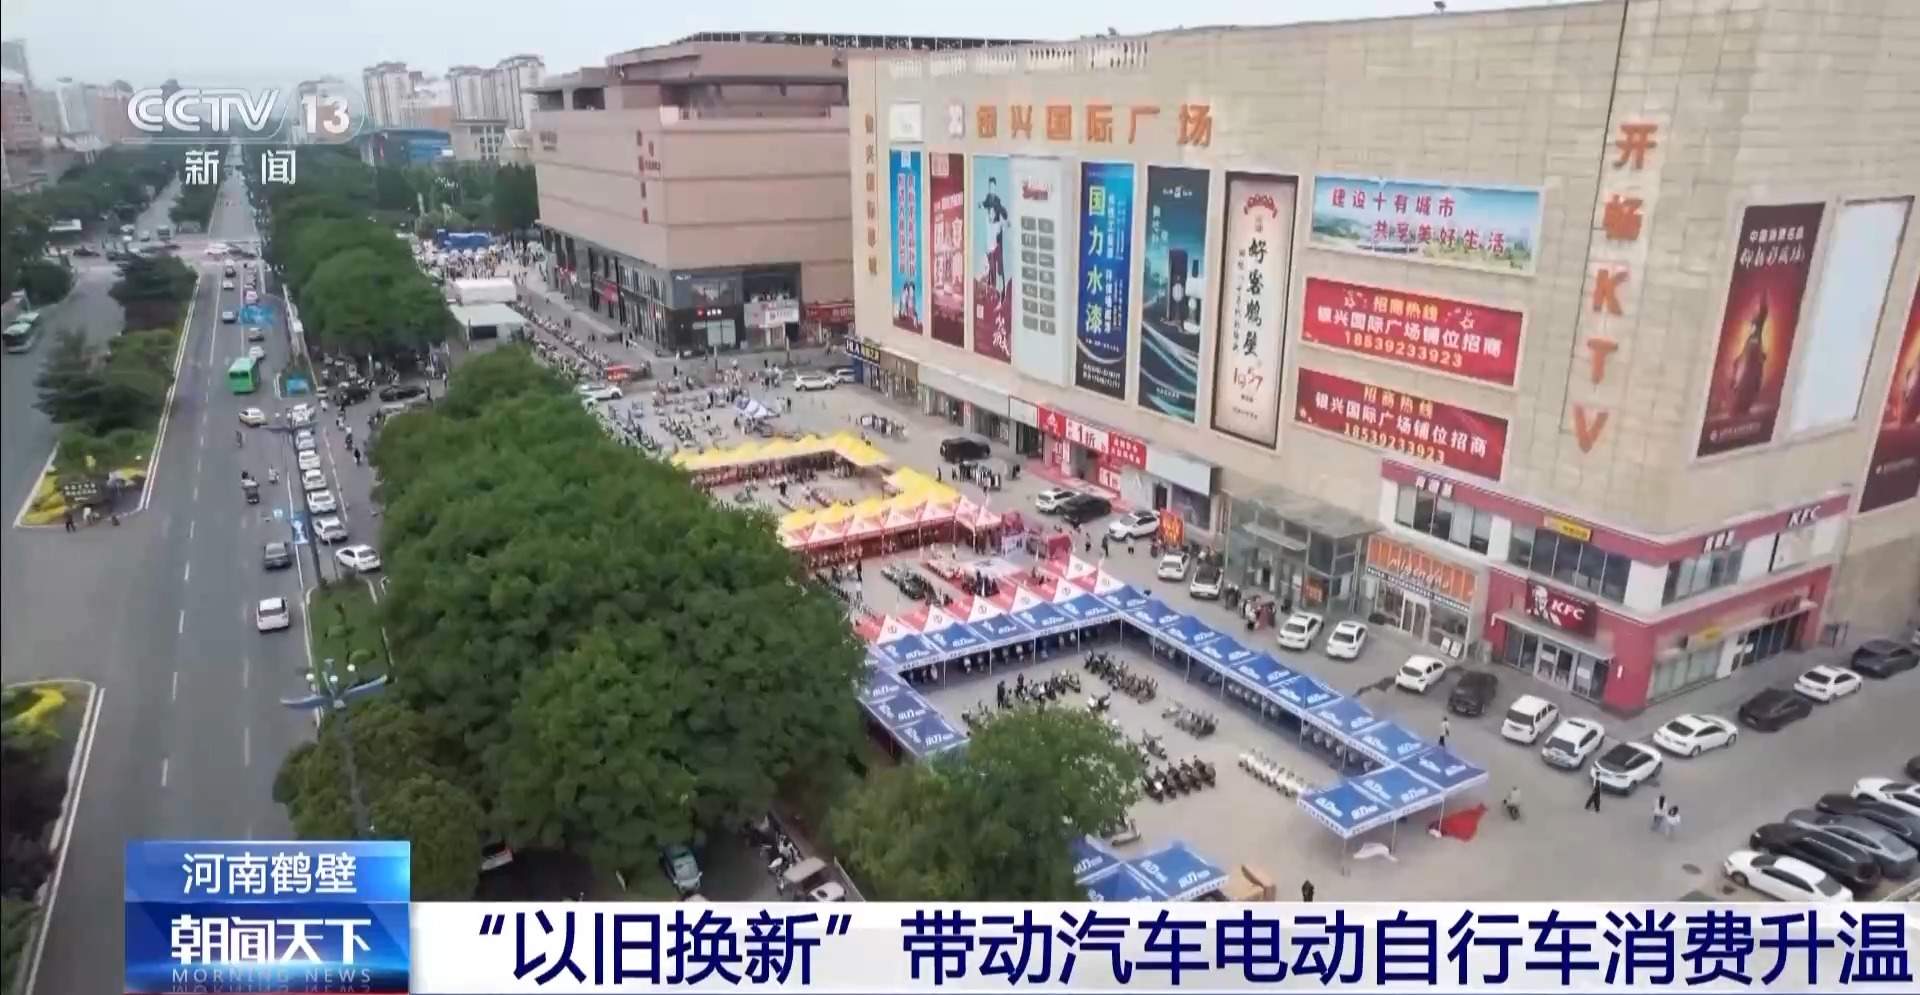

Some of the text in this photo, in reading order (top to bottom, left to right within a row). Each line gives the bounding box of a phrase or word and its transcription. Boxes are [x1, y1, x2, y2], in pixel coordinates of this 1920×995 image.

[1331, 187, 1455, 218] 建设十有城市
[1085, 186, 1105, 334] 国力水漆
[1373, 295, 1438, 322] 招商热线
[1344, 331, 1463, 368] 18539233923
[1363, 384, 1434, 419] 招商热线
[1315, 391, 1487, 458] 银兴国际广场铺位招商
[1344, 422, 1445, 464] 18539233923
[1789, 505, 1821, 527] KFC
[1551, 600, 1586, 621] KFC
